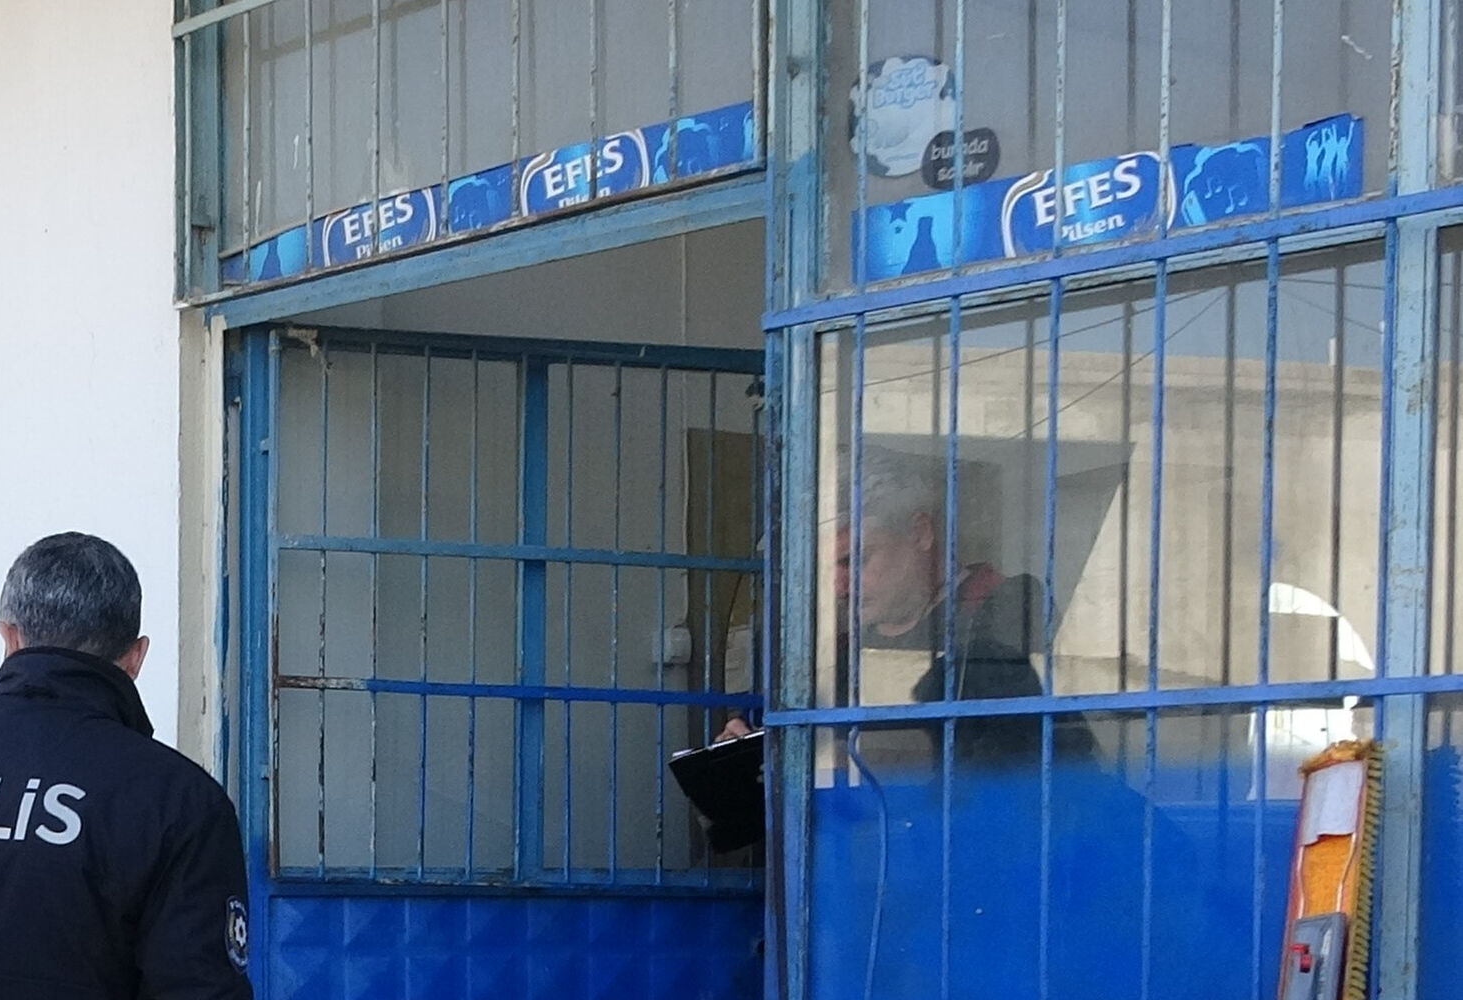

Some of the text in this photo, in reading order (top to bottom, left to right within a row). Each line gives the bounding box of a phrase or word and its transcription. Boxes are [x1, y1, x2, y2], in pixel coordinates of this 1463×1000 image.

[543, 139, 624, 199] EFES
[1032, 159, 1141, 227] EFES
[342, 194, 414, 245] EFES
